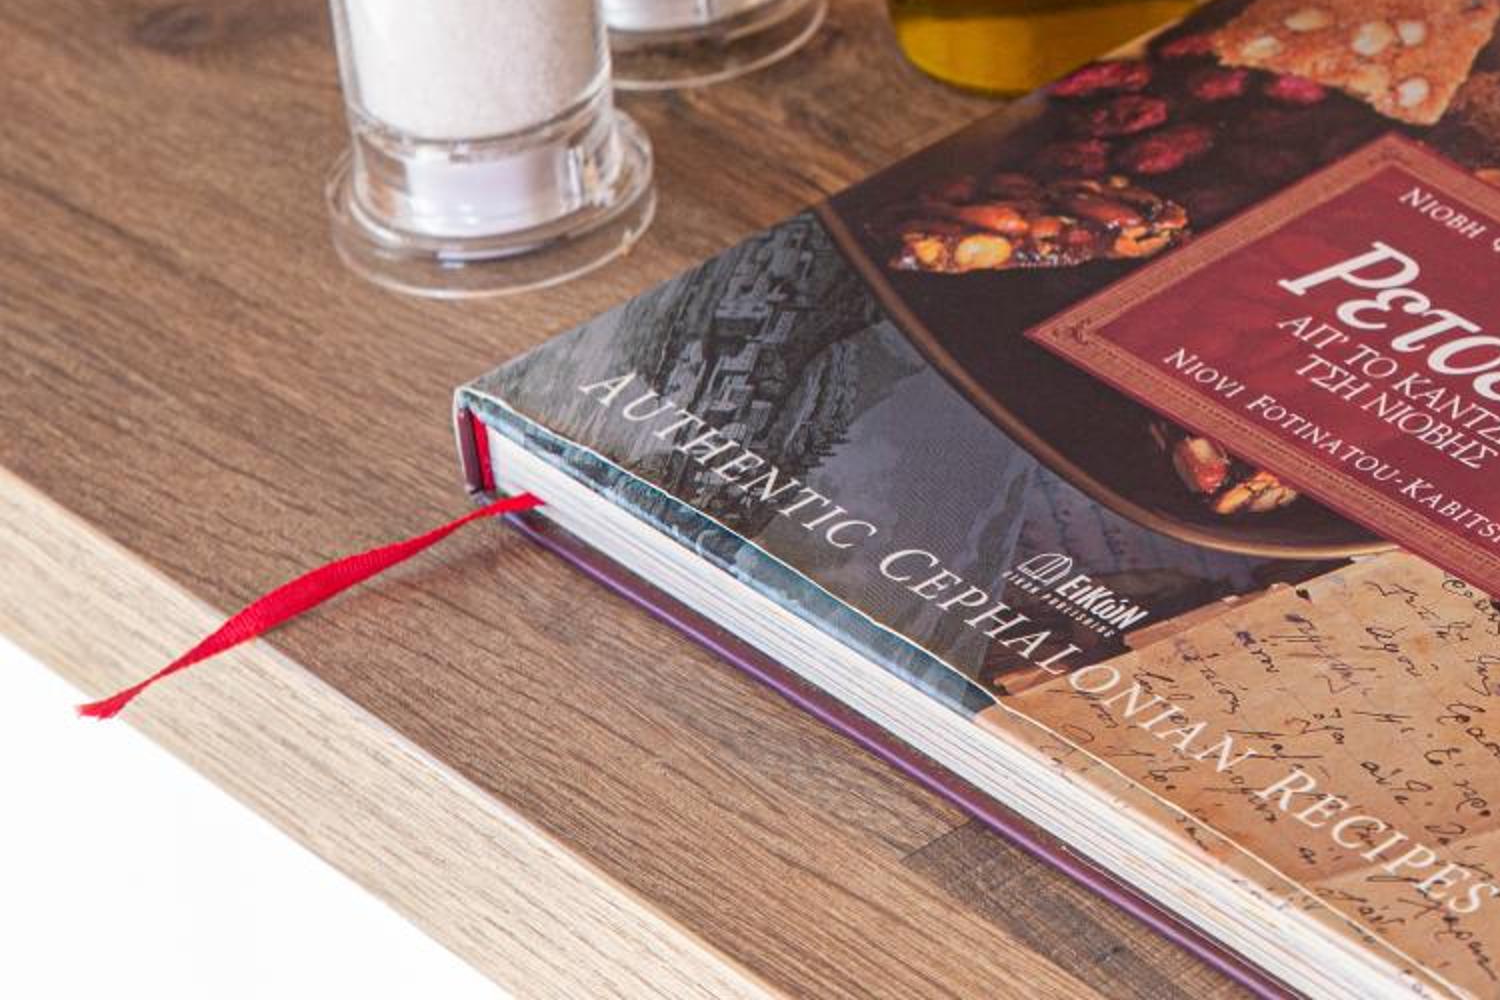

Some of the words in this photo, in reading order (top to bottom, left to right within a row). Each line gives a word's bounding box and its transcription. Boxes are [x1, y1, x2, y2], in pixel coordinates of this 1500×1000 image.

[1400, 186, 1486, 239] ΝΙΟΒΗ
[1164, 348, 1245, 398] NIOVI
[1345, 343, 1398, 379] ΤΟ
[1296, 354, 1370, 402] ΤΣΗ
[1362, 392, 1499, 469] ΝΙΟΒΗΣ
[580, 371, 876, 550] AUTHENTIC
[878, 547, 1257, 774] CEPHALONIAN
